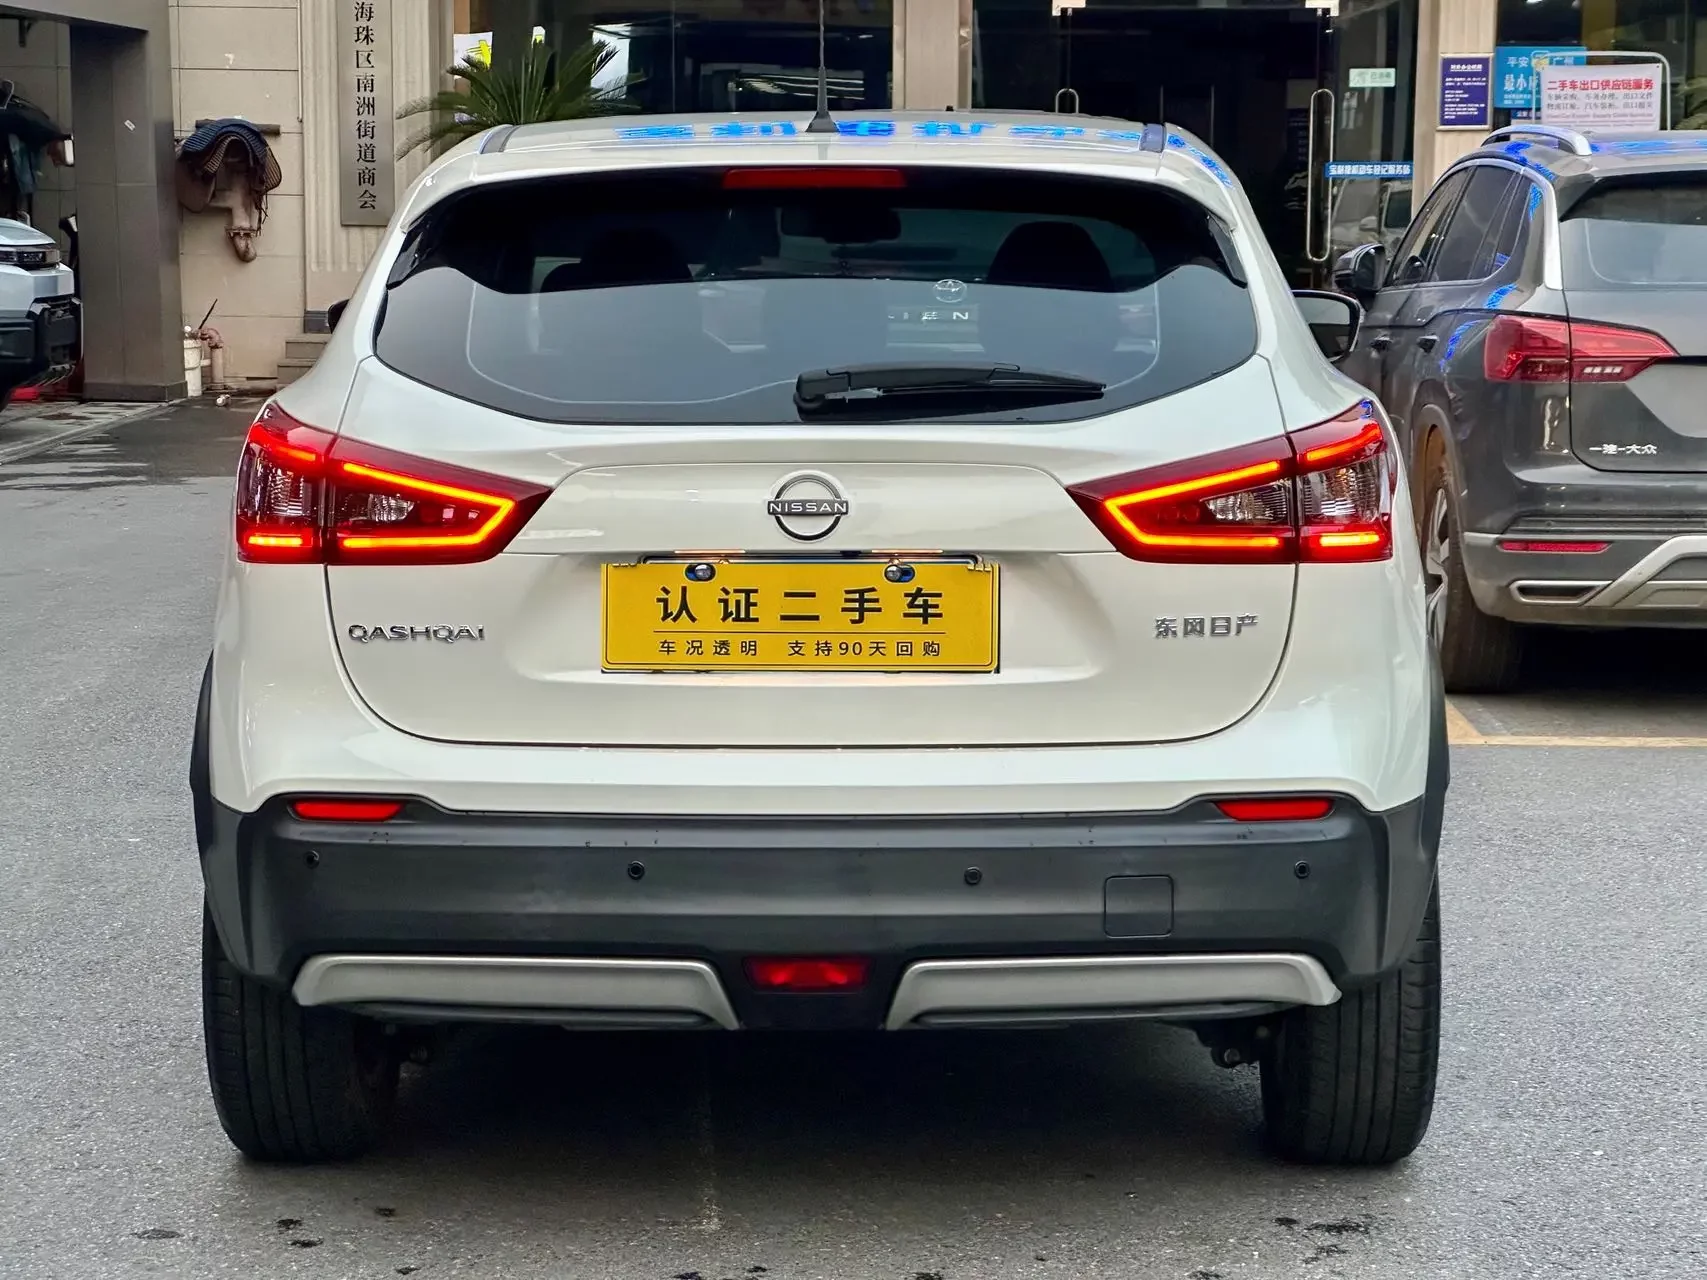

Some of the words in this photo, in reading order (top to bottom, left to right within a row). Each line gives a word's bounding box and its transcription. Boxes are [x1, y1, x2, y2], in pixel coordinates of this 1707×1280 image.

[1506, 57, 1529, 68] 平安
[1547, 78, 1654, 91] 二手车出口供应链服务
[354, 1, 377, 210] 海珠区南洲街道商会
[1589, 444, 1658, 455] 一汽-大众
[769, 502, 847, 513] NISSAN
[656, 586, 944, 625] 认证二手车
[348, 624, 486, 643] QASHQAI
[1155, 613, 1259, 638] 东风日产
[659, 639, 758, 657] 车况透明
[788, 639, 941, 657] 支持90天回购
